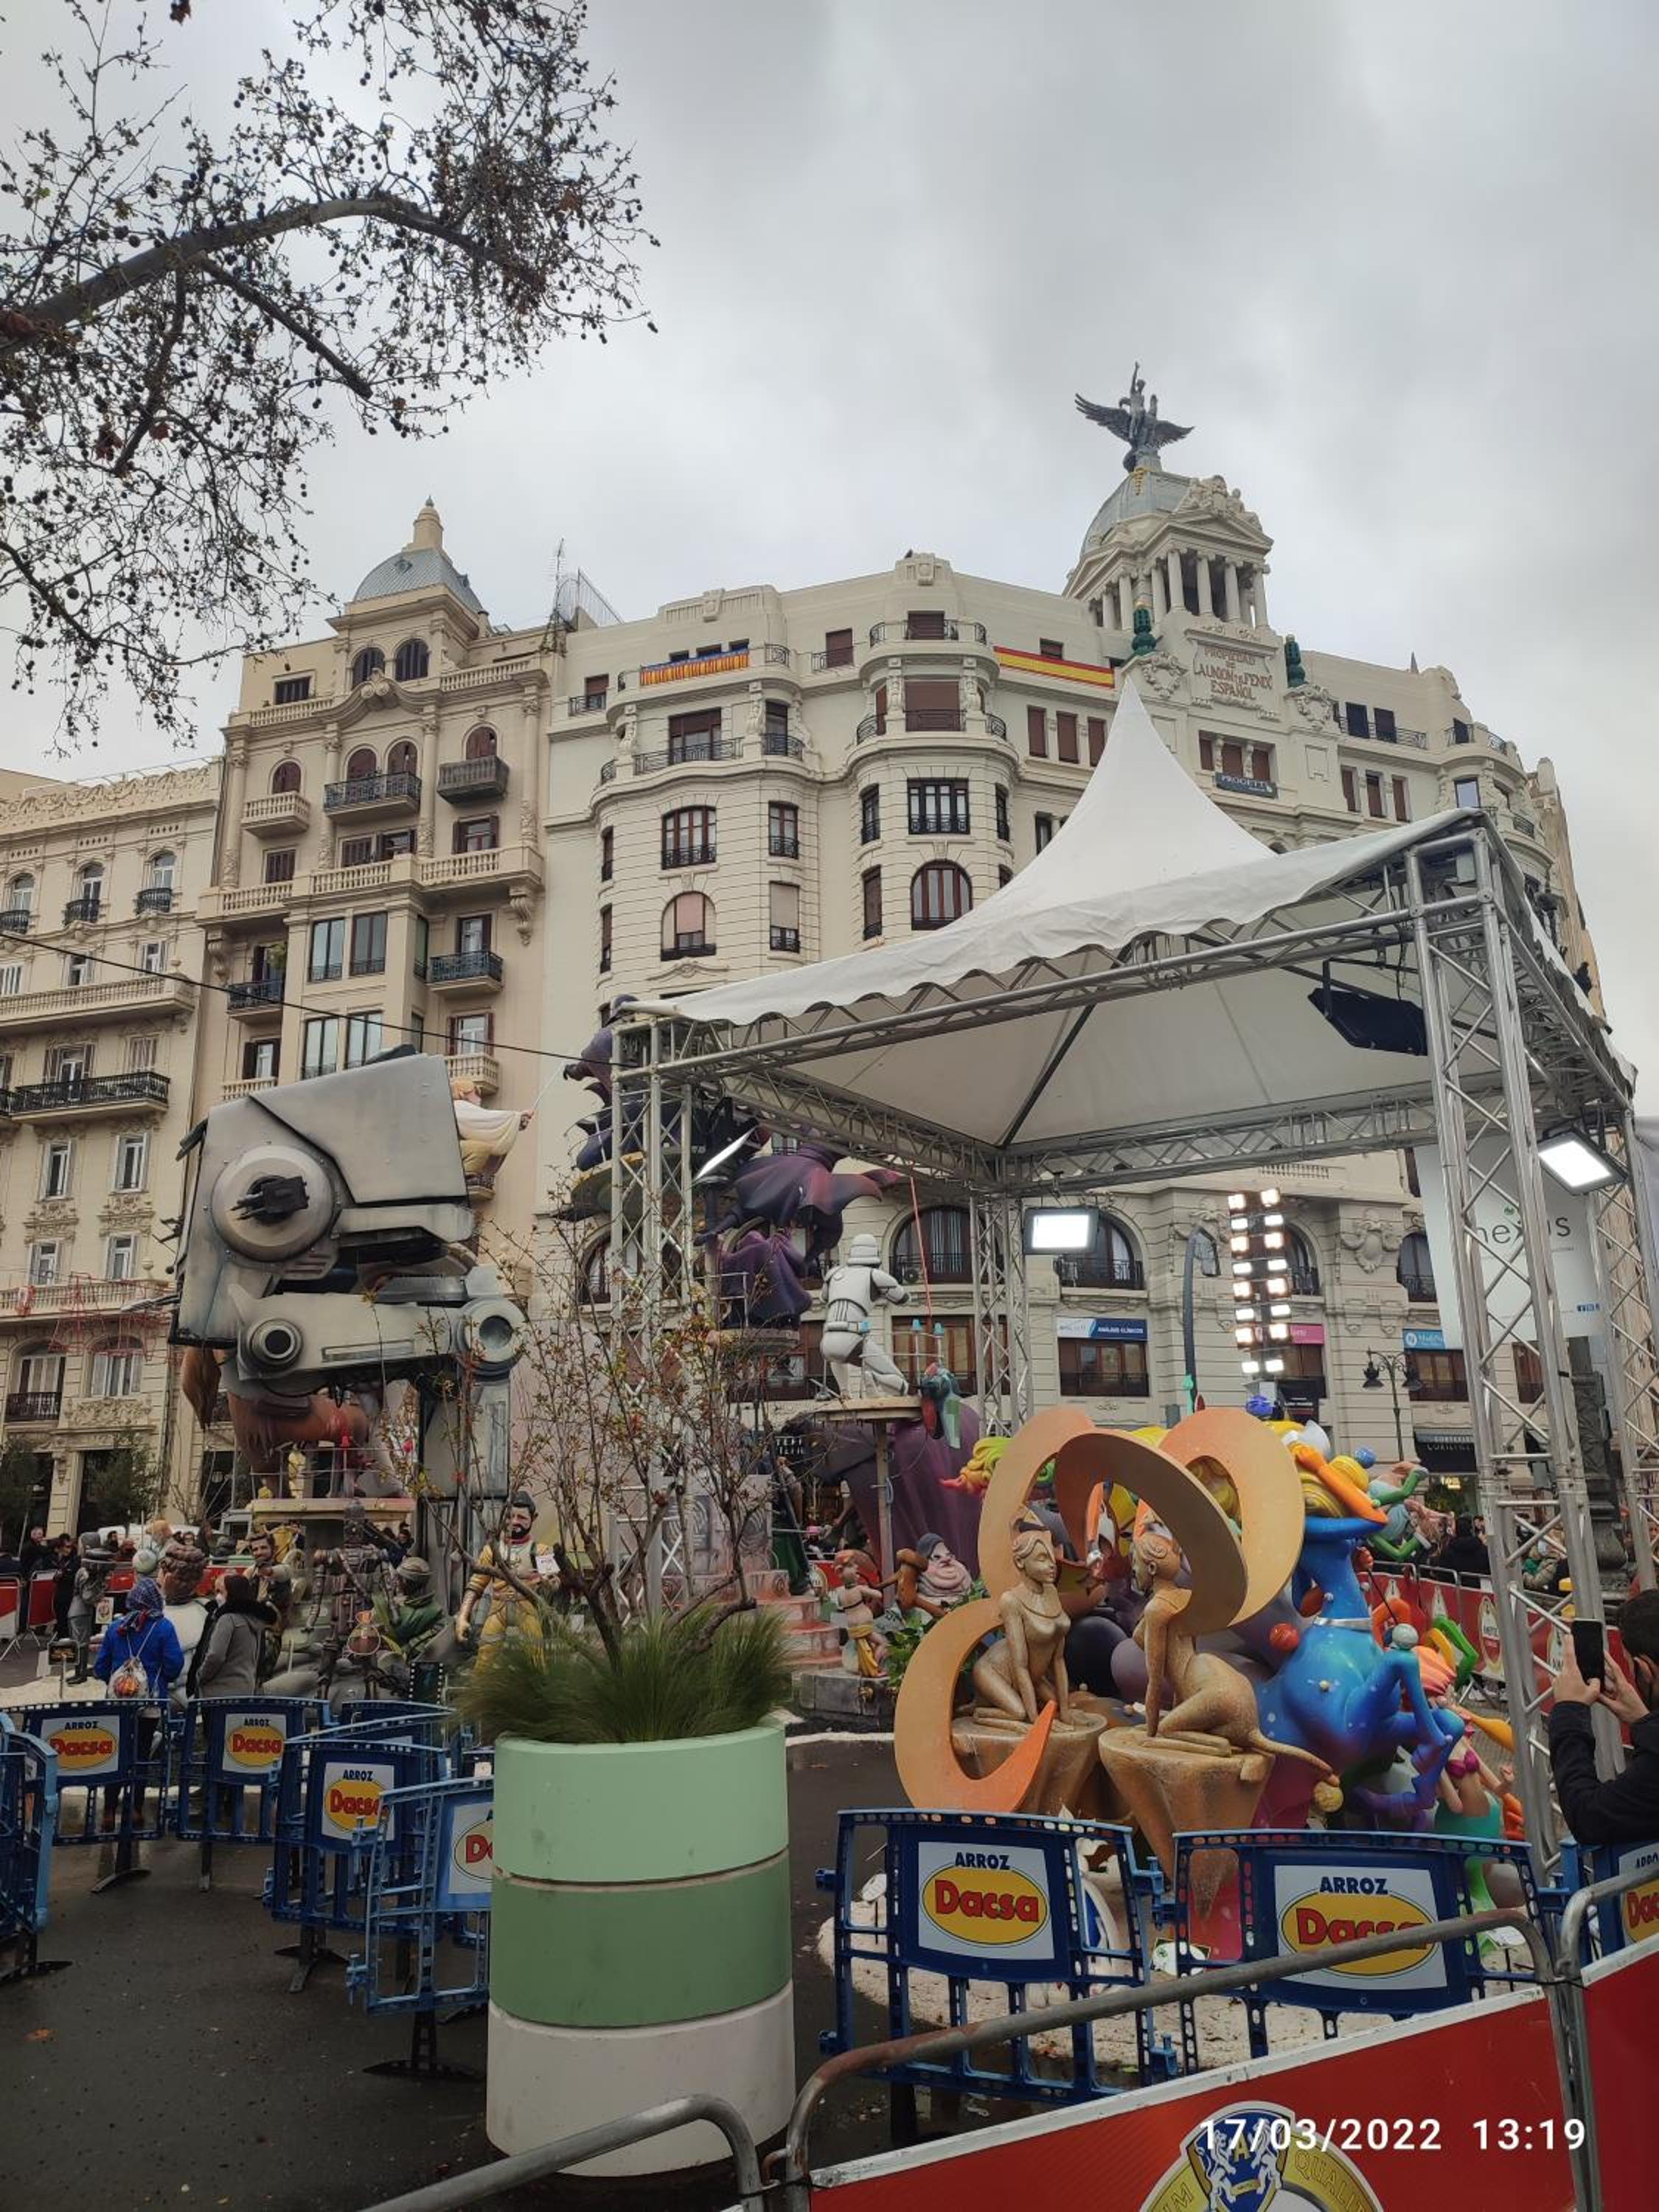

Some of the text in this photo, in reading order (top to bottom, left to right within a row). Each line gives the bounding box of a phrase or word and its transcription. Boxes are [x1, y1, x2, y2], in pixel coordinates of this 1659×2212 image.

[1476, 1217, 1571, 1245] nexs
[64, 1721, 100, 1730] ARROZ
[244, 1718, 271, 1727] ARROZ
[50, 1738, 113, 1756] Dacsa
[232, 1733, 282, 1754] Dacsa
[343, 1769, 374, 1782] ARROZ
[955, 1851, 1011, 1871] ARROZ
[1635, 1851, 1659, 1869] ARRO
[1319, 1877, 1388, 1895] ARROZ
[934, 1879, 1040, 1923] Dacsa
[1627, 1889, 1659, 1929] Dac
